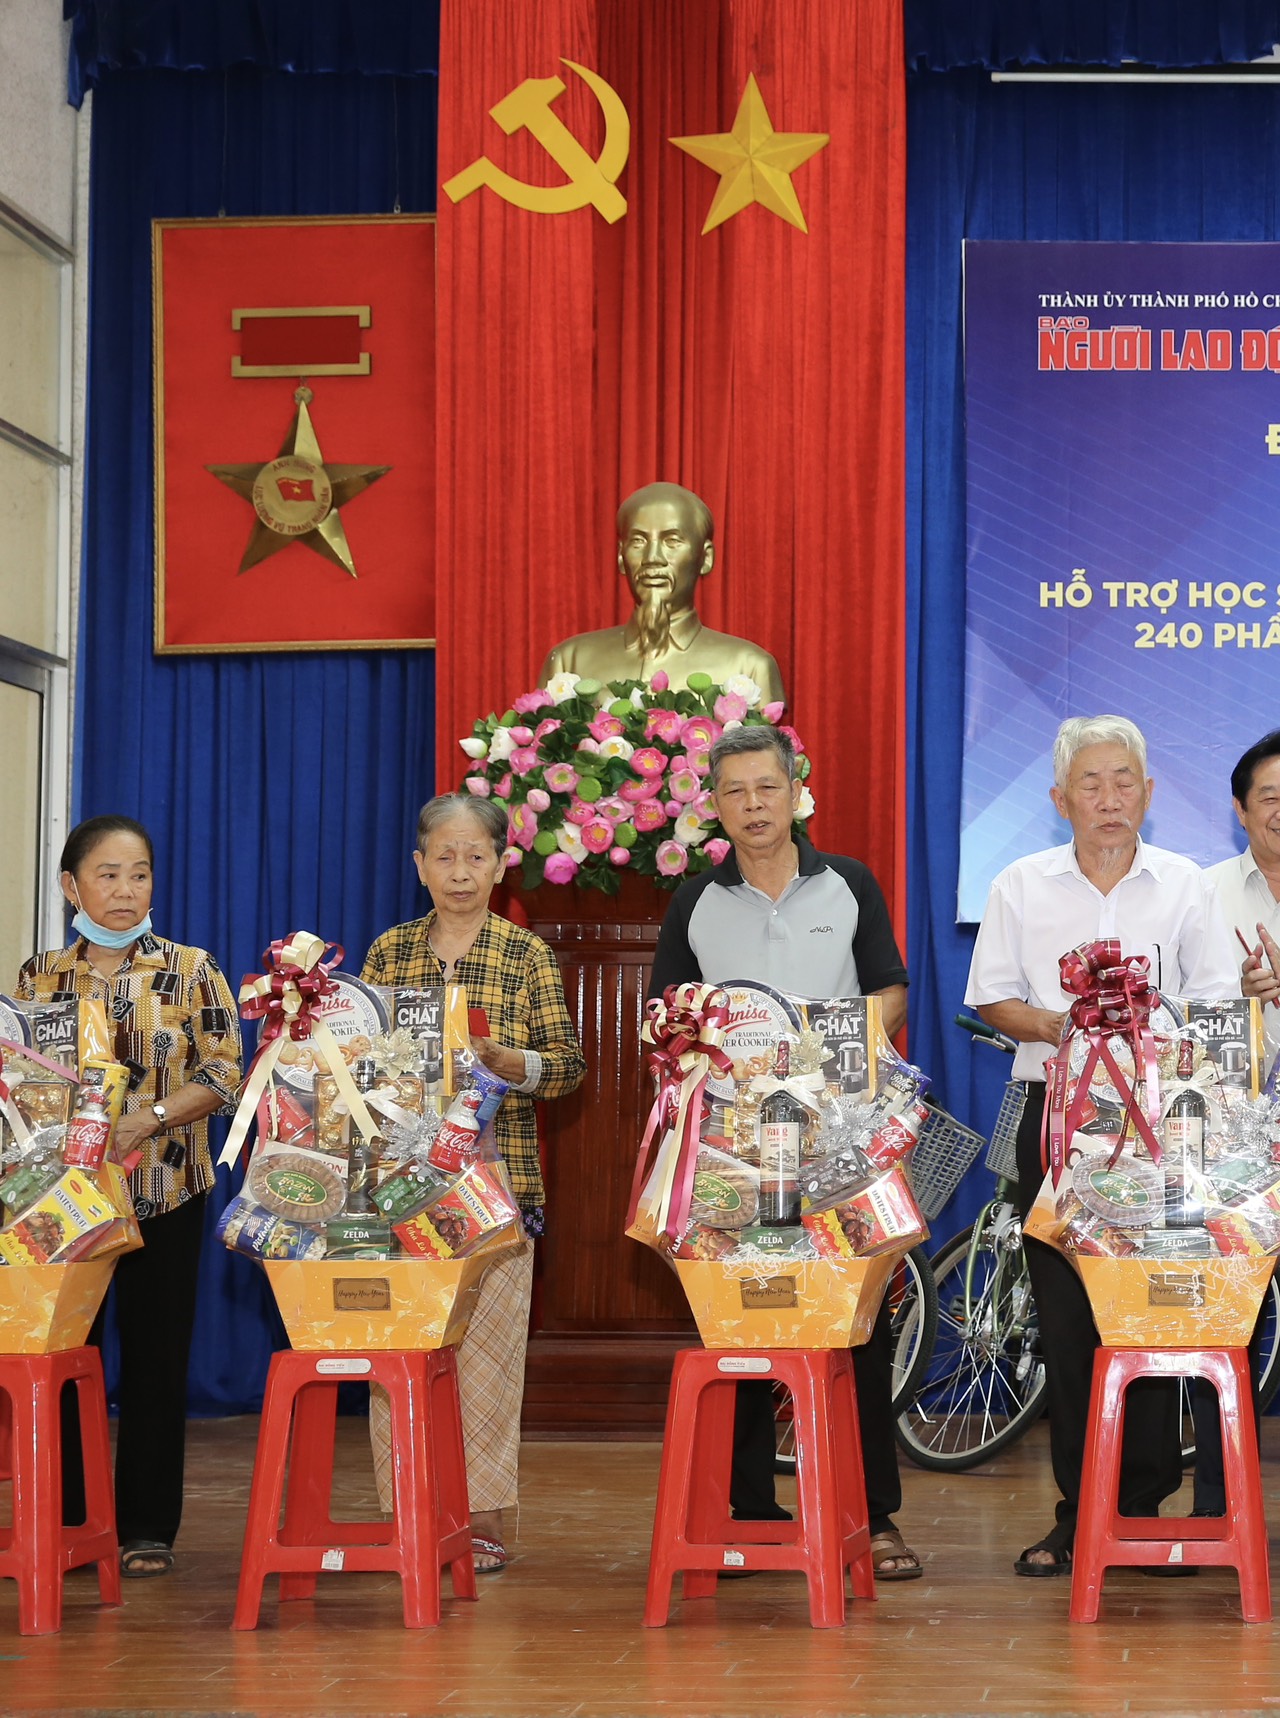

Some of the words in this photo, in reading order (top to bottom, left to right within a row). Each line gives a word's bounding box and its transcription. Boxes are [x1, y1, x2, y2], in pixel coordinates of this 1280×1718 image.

[1039, 291, 1098, 308] THÀNH
[1103, 291, 1125, 308] ỦY
[1130, 291, 1188, 308] THÀNH
[1161, 329, 1232, 371] LAO
[1040, 568, 1092, 608] HỖ
[1103, 577, 1178, 614] TRỢ
[1189, 582, 1266, 614] HỌC
[1135, 623, 1203, 649] 240
[728, 1003, 771, 1022] anisa
[343, 1230, 370, 1239] ZELDA
[757, 1236, 784, 1245] ZELDA
